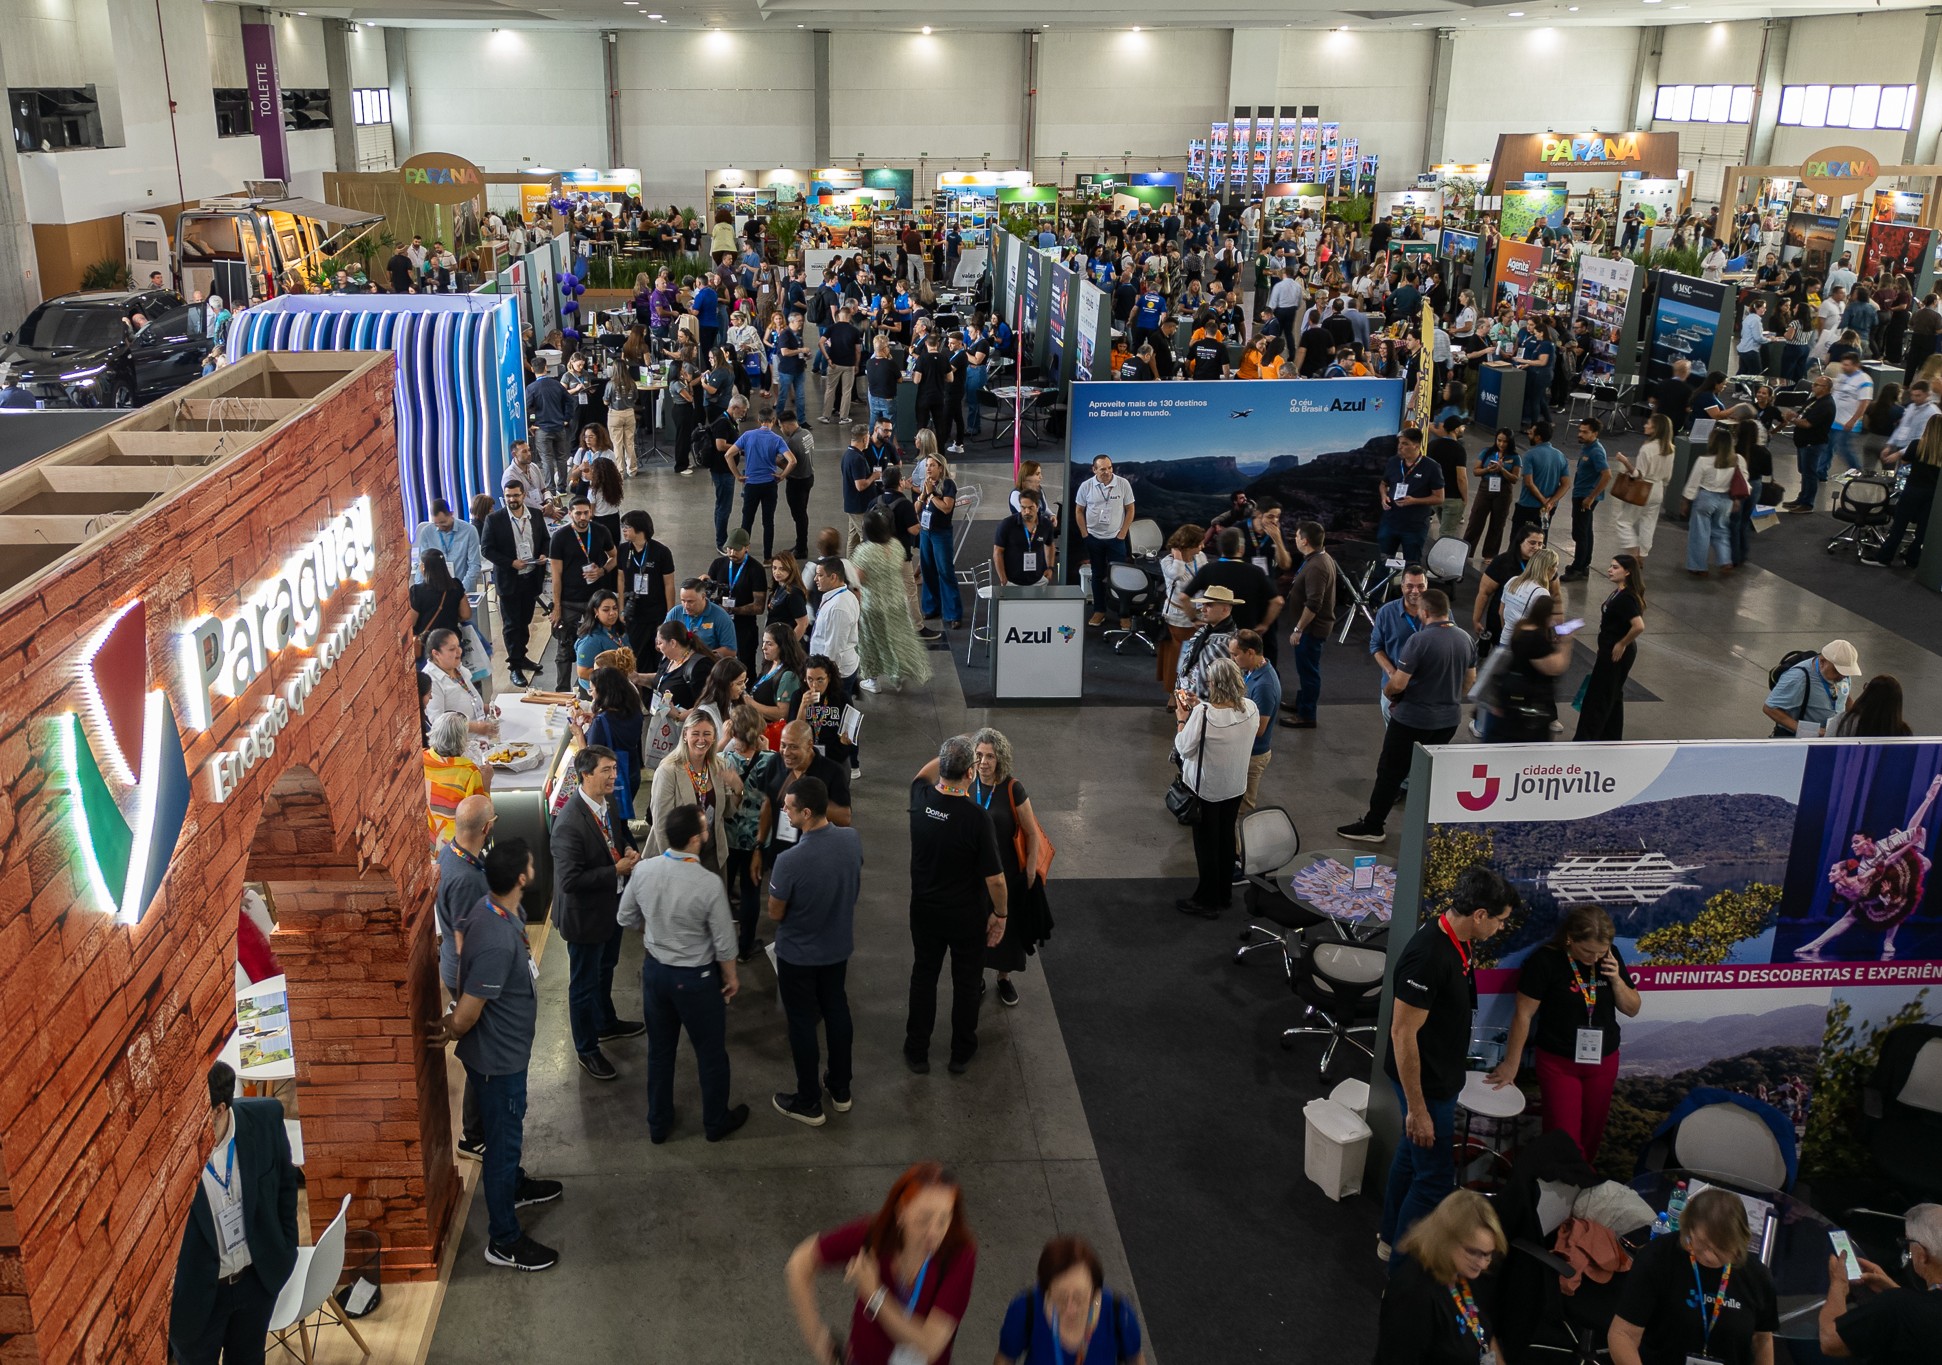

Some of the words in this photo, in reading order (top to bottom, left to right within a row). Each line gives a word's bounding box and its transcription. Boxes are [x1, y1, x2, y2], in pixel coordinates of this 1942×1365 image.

[255, 63, 272, 117] TOILETTE
[1678, 283, 1693, 295] MSC
[1088, 400, 1125, 408] Aproveite
[1174, 399, 1207, 407] destinos
[1289, 405, 1300, 413] do
[1301, 405, 1322, 413] Brasil
[1323, 405, 1329, 413] é
[1329, 397, 1366, 411] Azul
[1290, 398, 1297, 406] O
[1298, 398, 1313, 406] céu
[1485, 392, 1498, 405] MSC
[1100, 409, 1123, 417] Brasil
[1142, 409, 1171, 417] mundo.
[1004, 626, 1052, 644] Azul
[288, 656, 322, 716] que
[320, 590, 377, 669] conecta
[1522, 764, 1563, 776] cidade
[1566, 763, 1582, 775] de
[1505, 771, 1616, 801] Joinville
[1654, 970, 1734, 985] INFINITAS
[1738, 967, 1851, 983] DESCOBERTAS
[1853, 967, 1865, 980] E
[1703, 1293, 1741, 1309] Joiville
